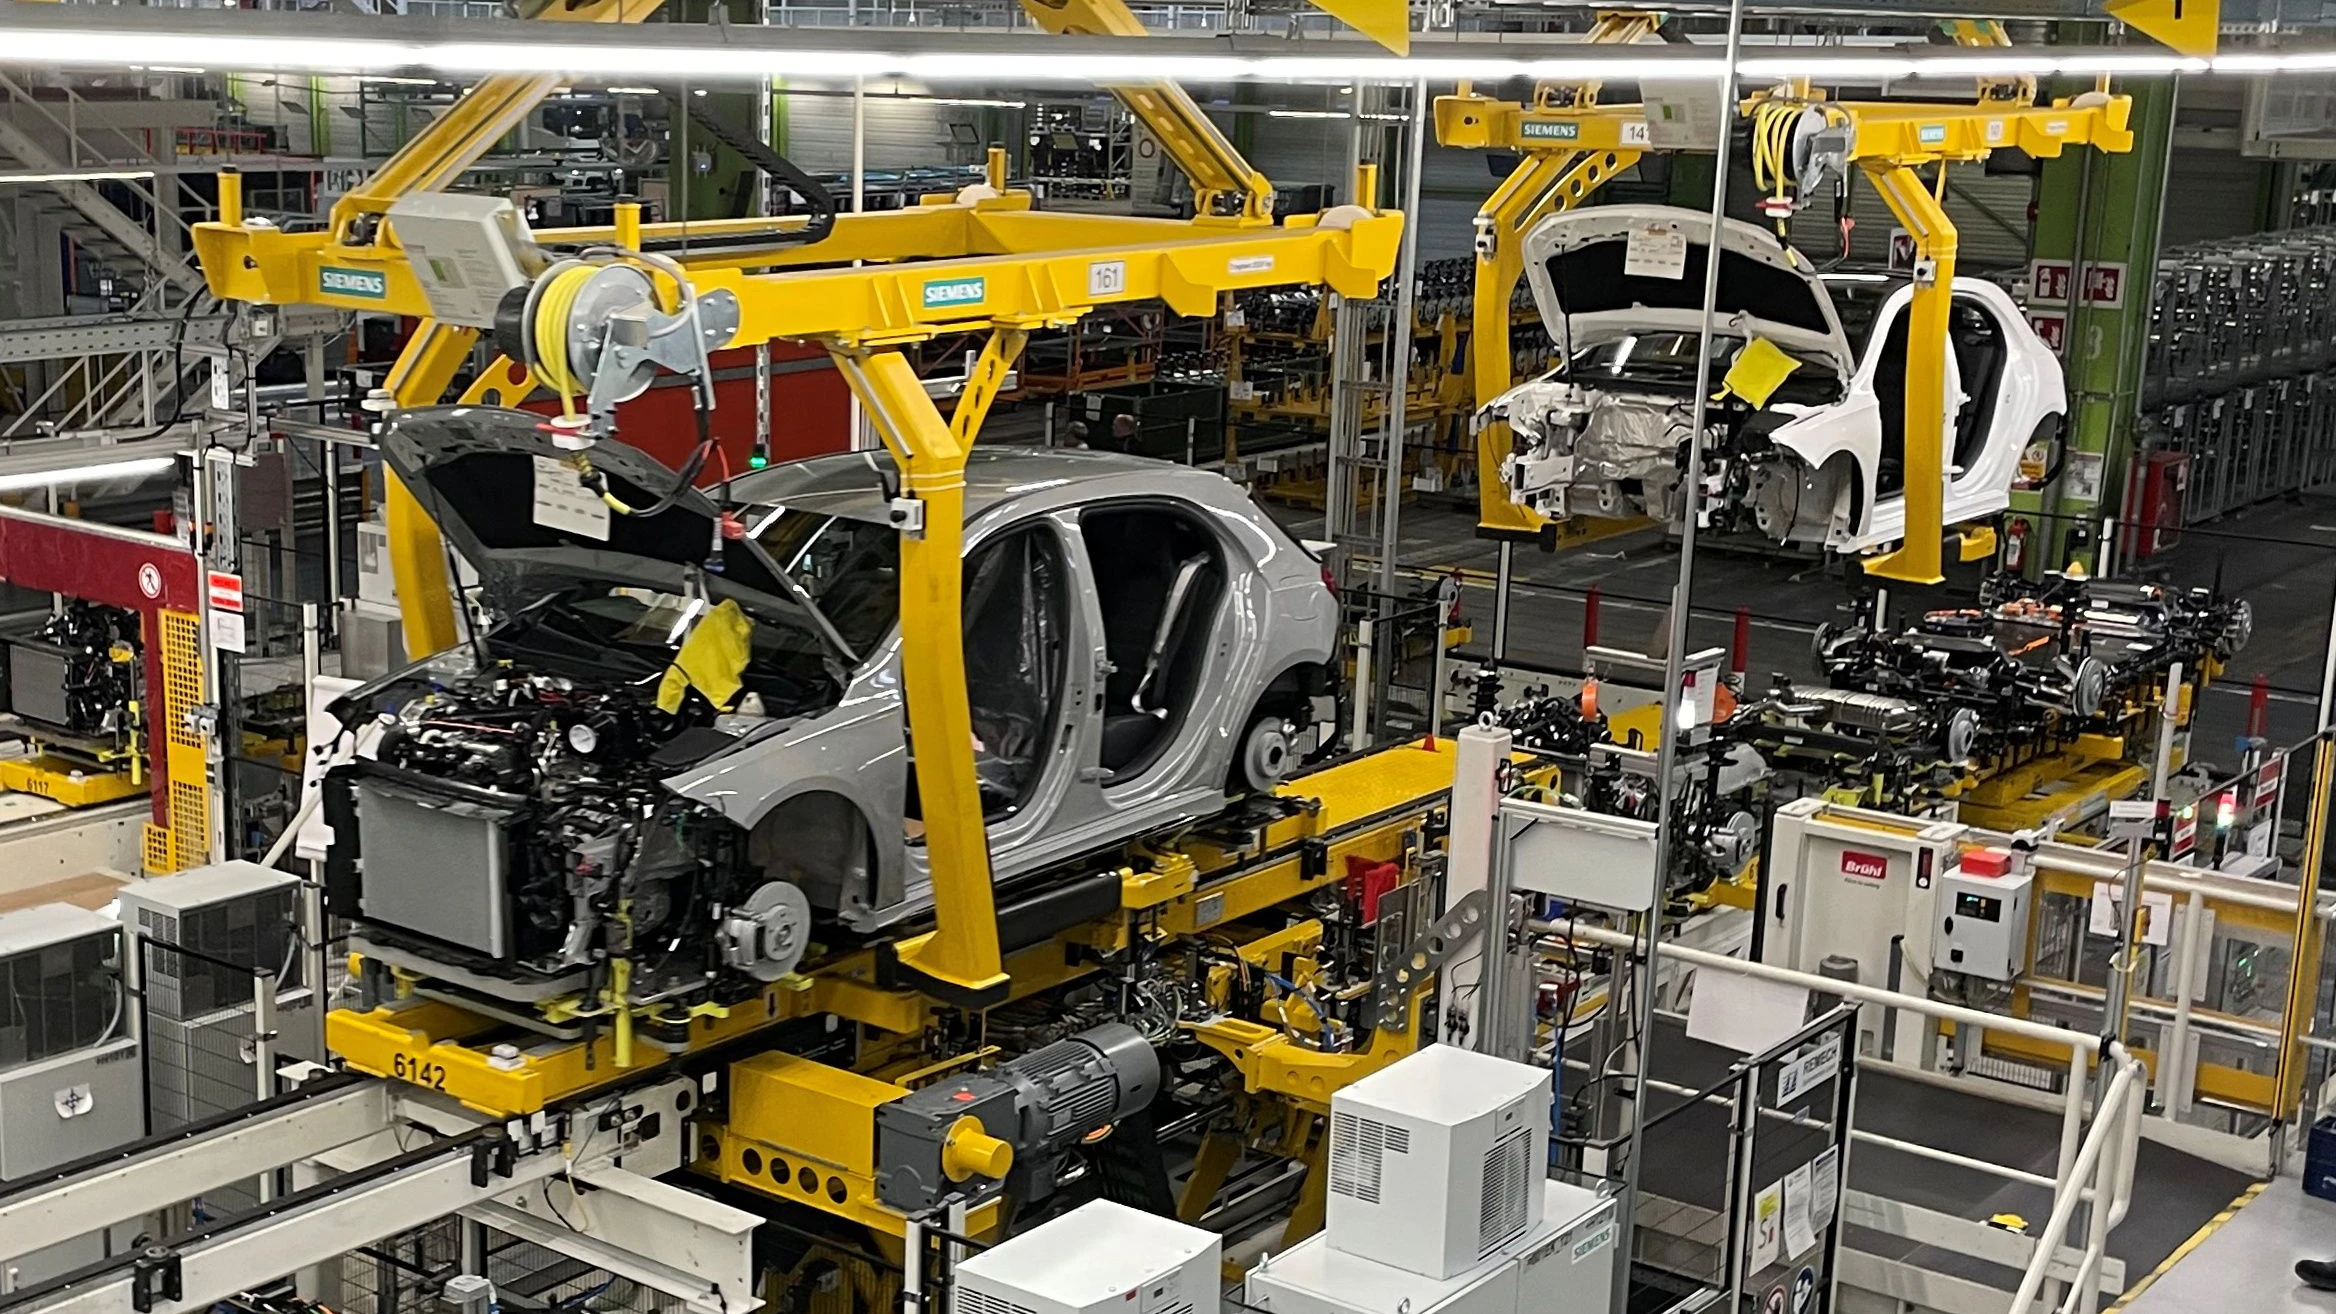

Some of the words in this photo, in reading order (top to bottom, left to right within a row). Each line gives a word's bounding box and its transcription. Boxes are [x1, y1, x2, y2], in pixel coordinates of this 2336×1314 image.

[1524, 123, 1576, 137] SIEMENS
[1629, 125, 1648, 140] 14
[323, 272, 383, 293] SIEMENS
[1096, 267, 1118, 289] 161
[925, 282, 982, 303] SIEMENS
[26, 777, 49, 794] 6117
[1846, 860, 1882, 877] Brühl
[394, 1052, 446, 1092] 6142
